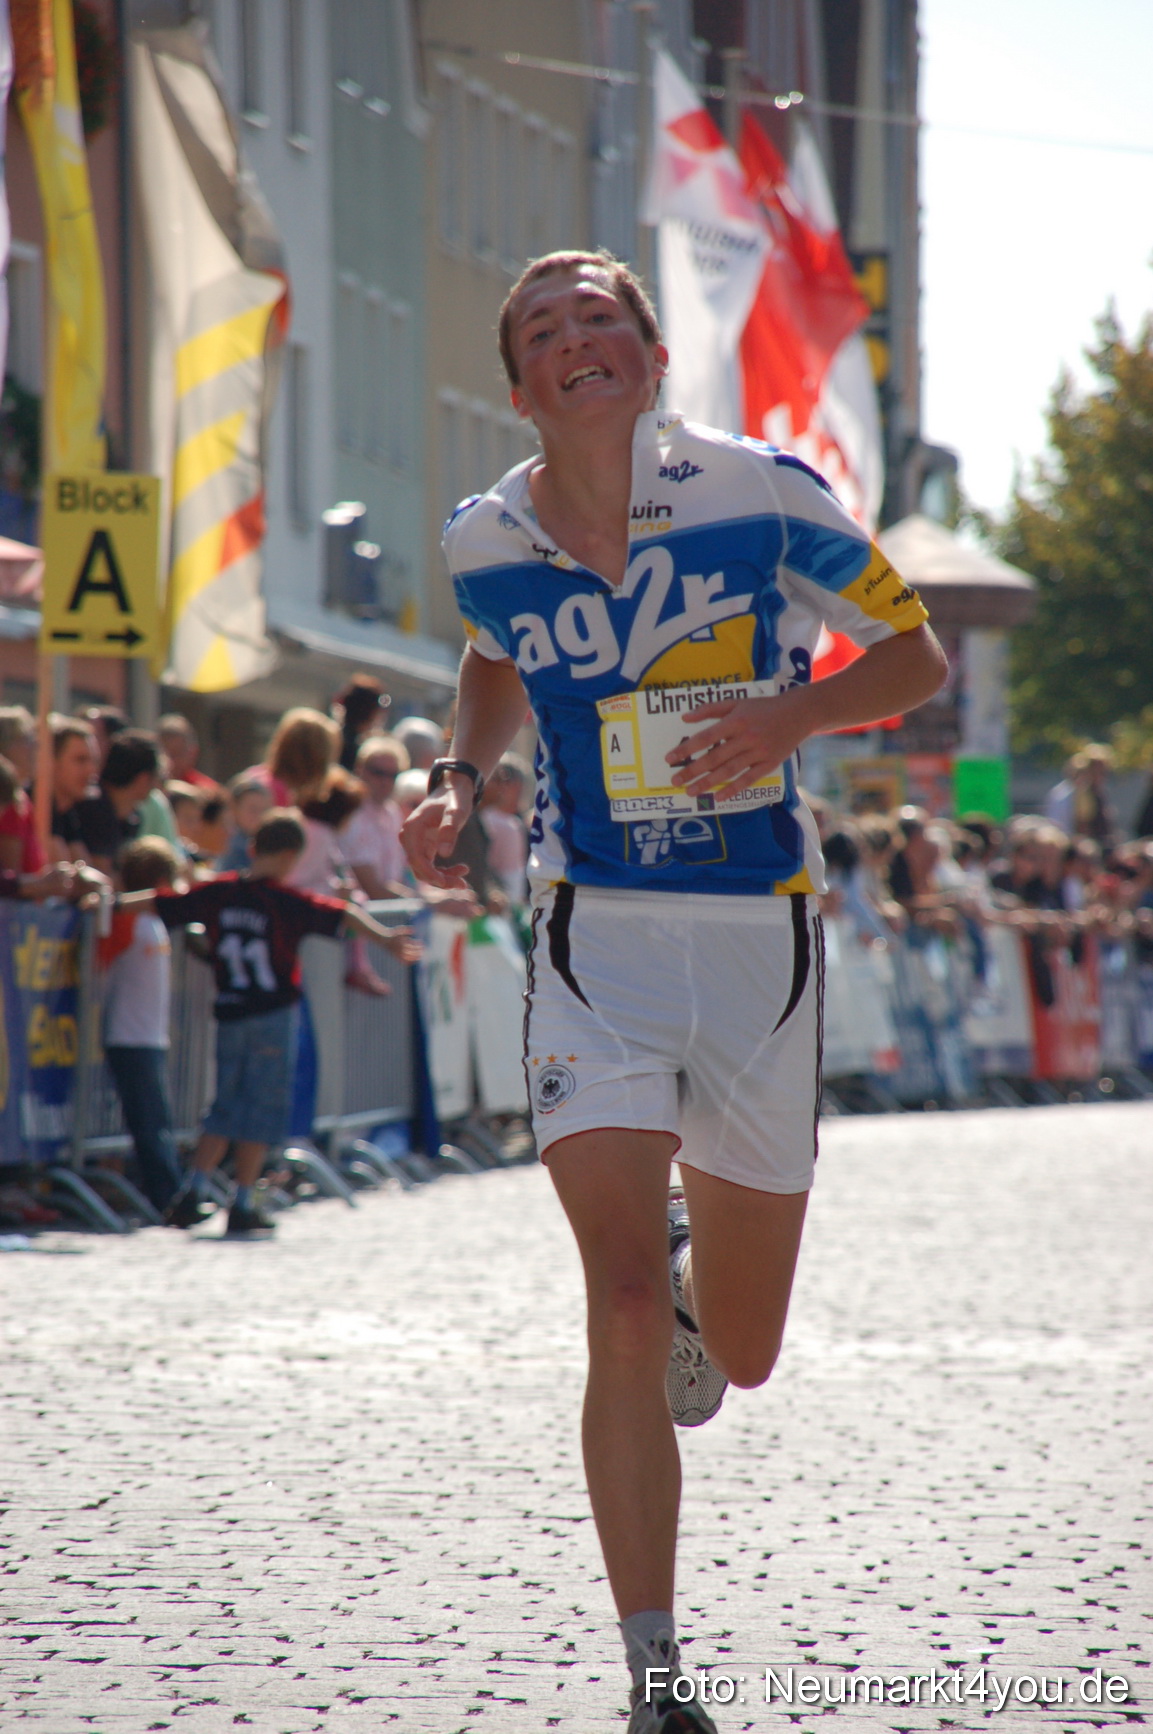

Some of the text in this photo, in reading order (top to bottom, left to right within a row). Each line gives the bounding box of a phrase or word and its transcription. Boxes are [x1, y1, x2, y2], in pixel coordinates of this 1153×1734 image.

[658, 460, 704, 484] ag2r
[57, 479, 148, 515] Block
[67, 528, 134, 614] A
[510, 545, 754, 683] ag2r
[645, 686, 748, 714] Christian
[611, 733, 621, 753] A
[612, 796, 674, 813] BOCK
[218, 934, 276, 992] 11
